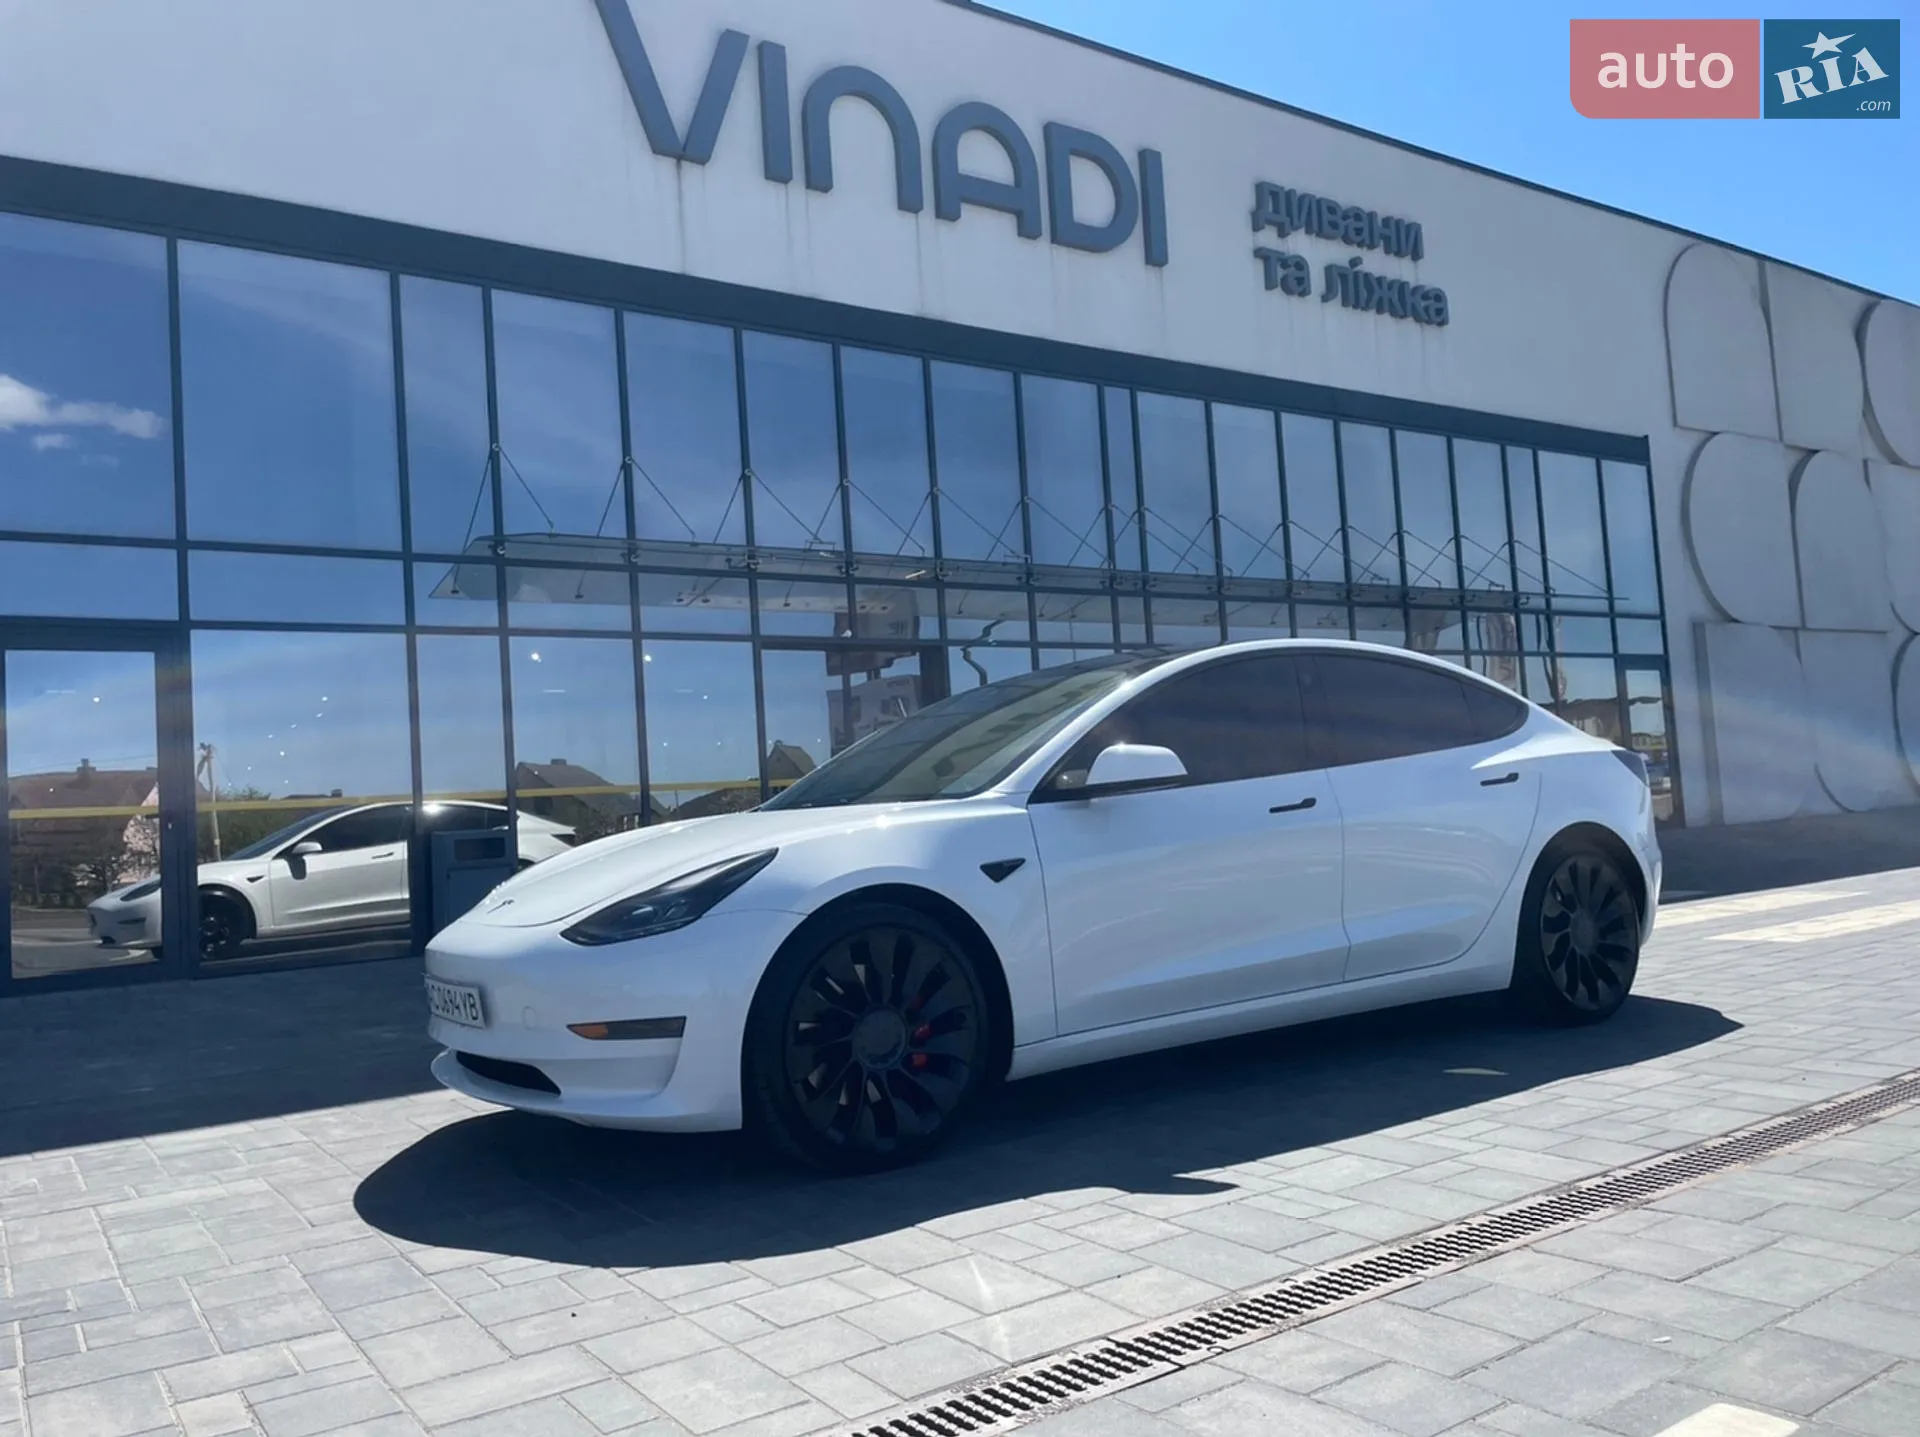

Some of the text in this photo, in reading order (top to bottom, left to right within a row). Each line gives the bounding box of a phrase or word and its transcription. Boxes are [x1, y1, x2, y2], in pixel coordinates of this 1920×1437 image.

[593, 0, 1168, 268] VINADI
[1252, 180, 1424, 261] дивани
[1253, 246, 1449, 326] та ліжка
